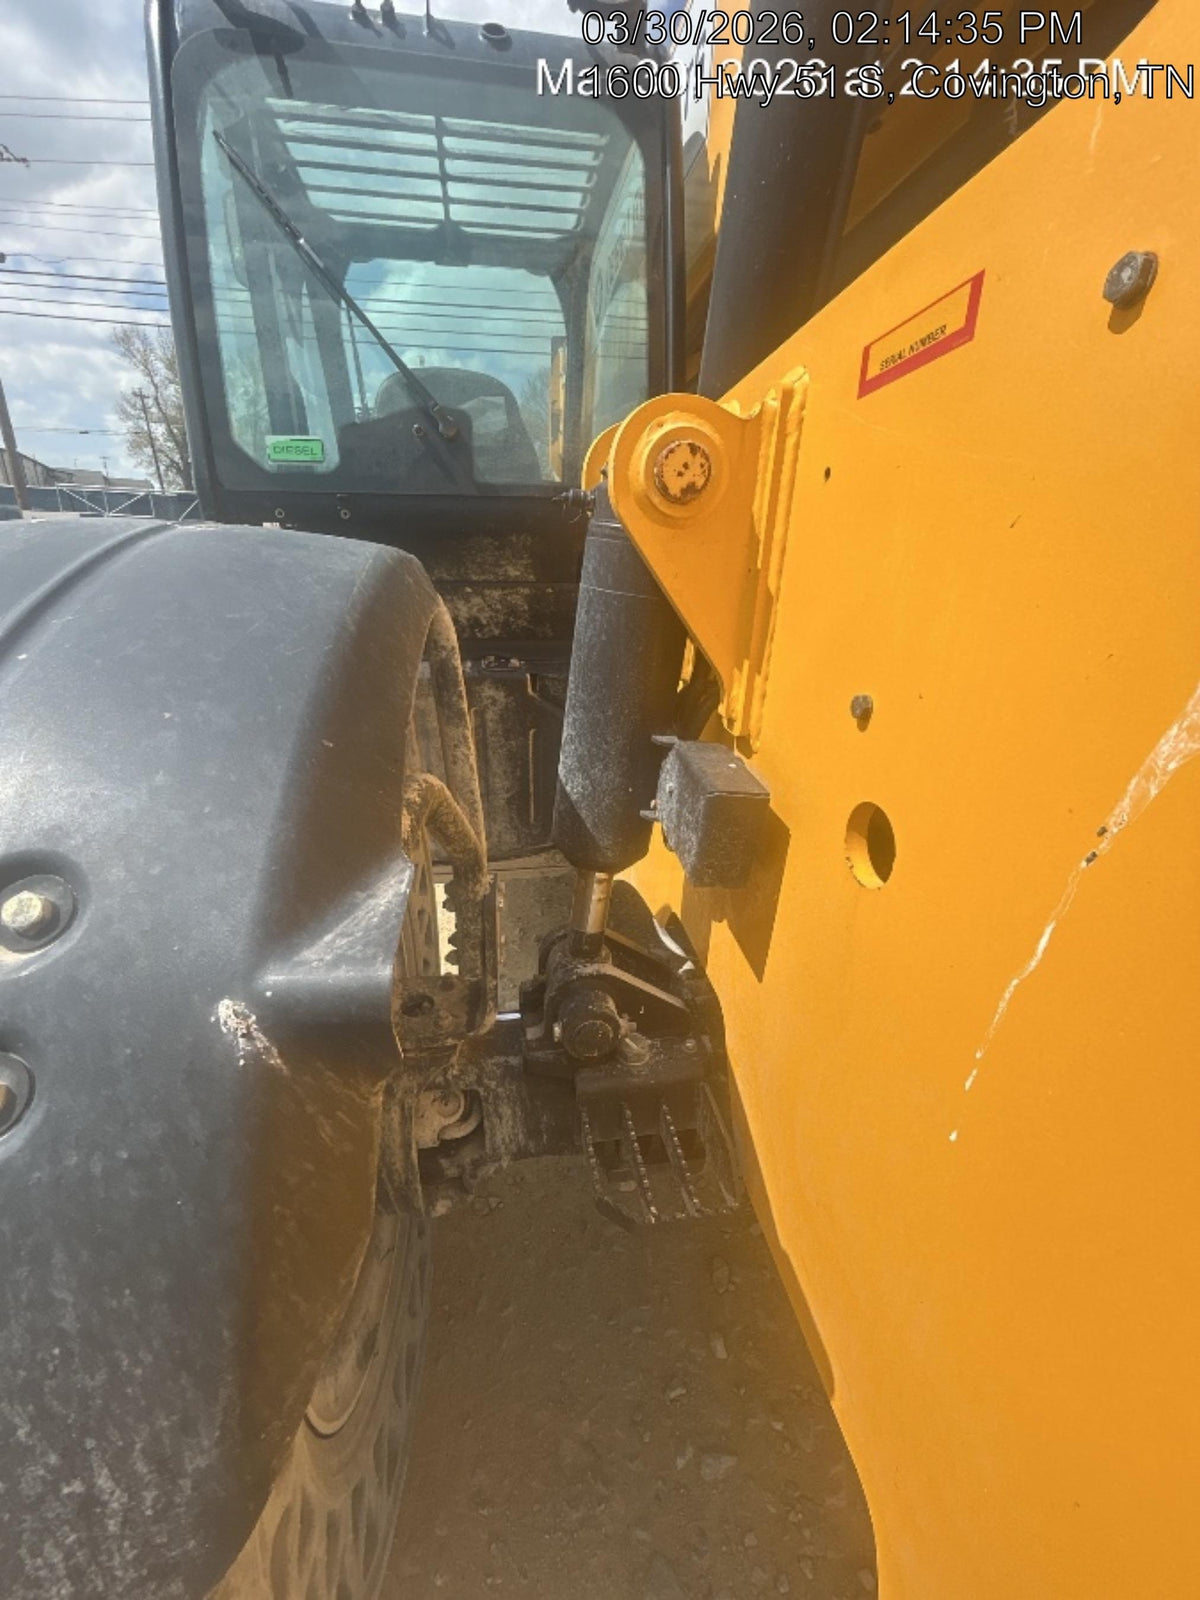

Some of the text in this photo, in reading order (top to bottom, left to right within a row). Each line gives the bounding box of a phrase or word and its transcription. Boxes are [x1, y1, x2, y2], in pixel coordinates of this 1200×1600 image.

[879, 324, 947, 372] SERIAL NUMBER
[272, 445, 318, 456] DIESEL
